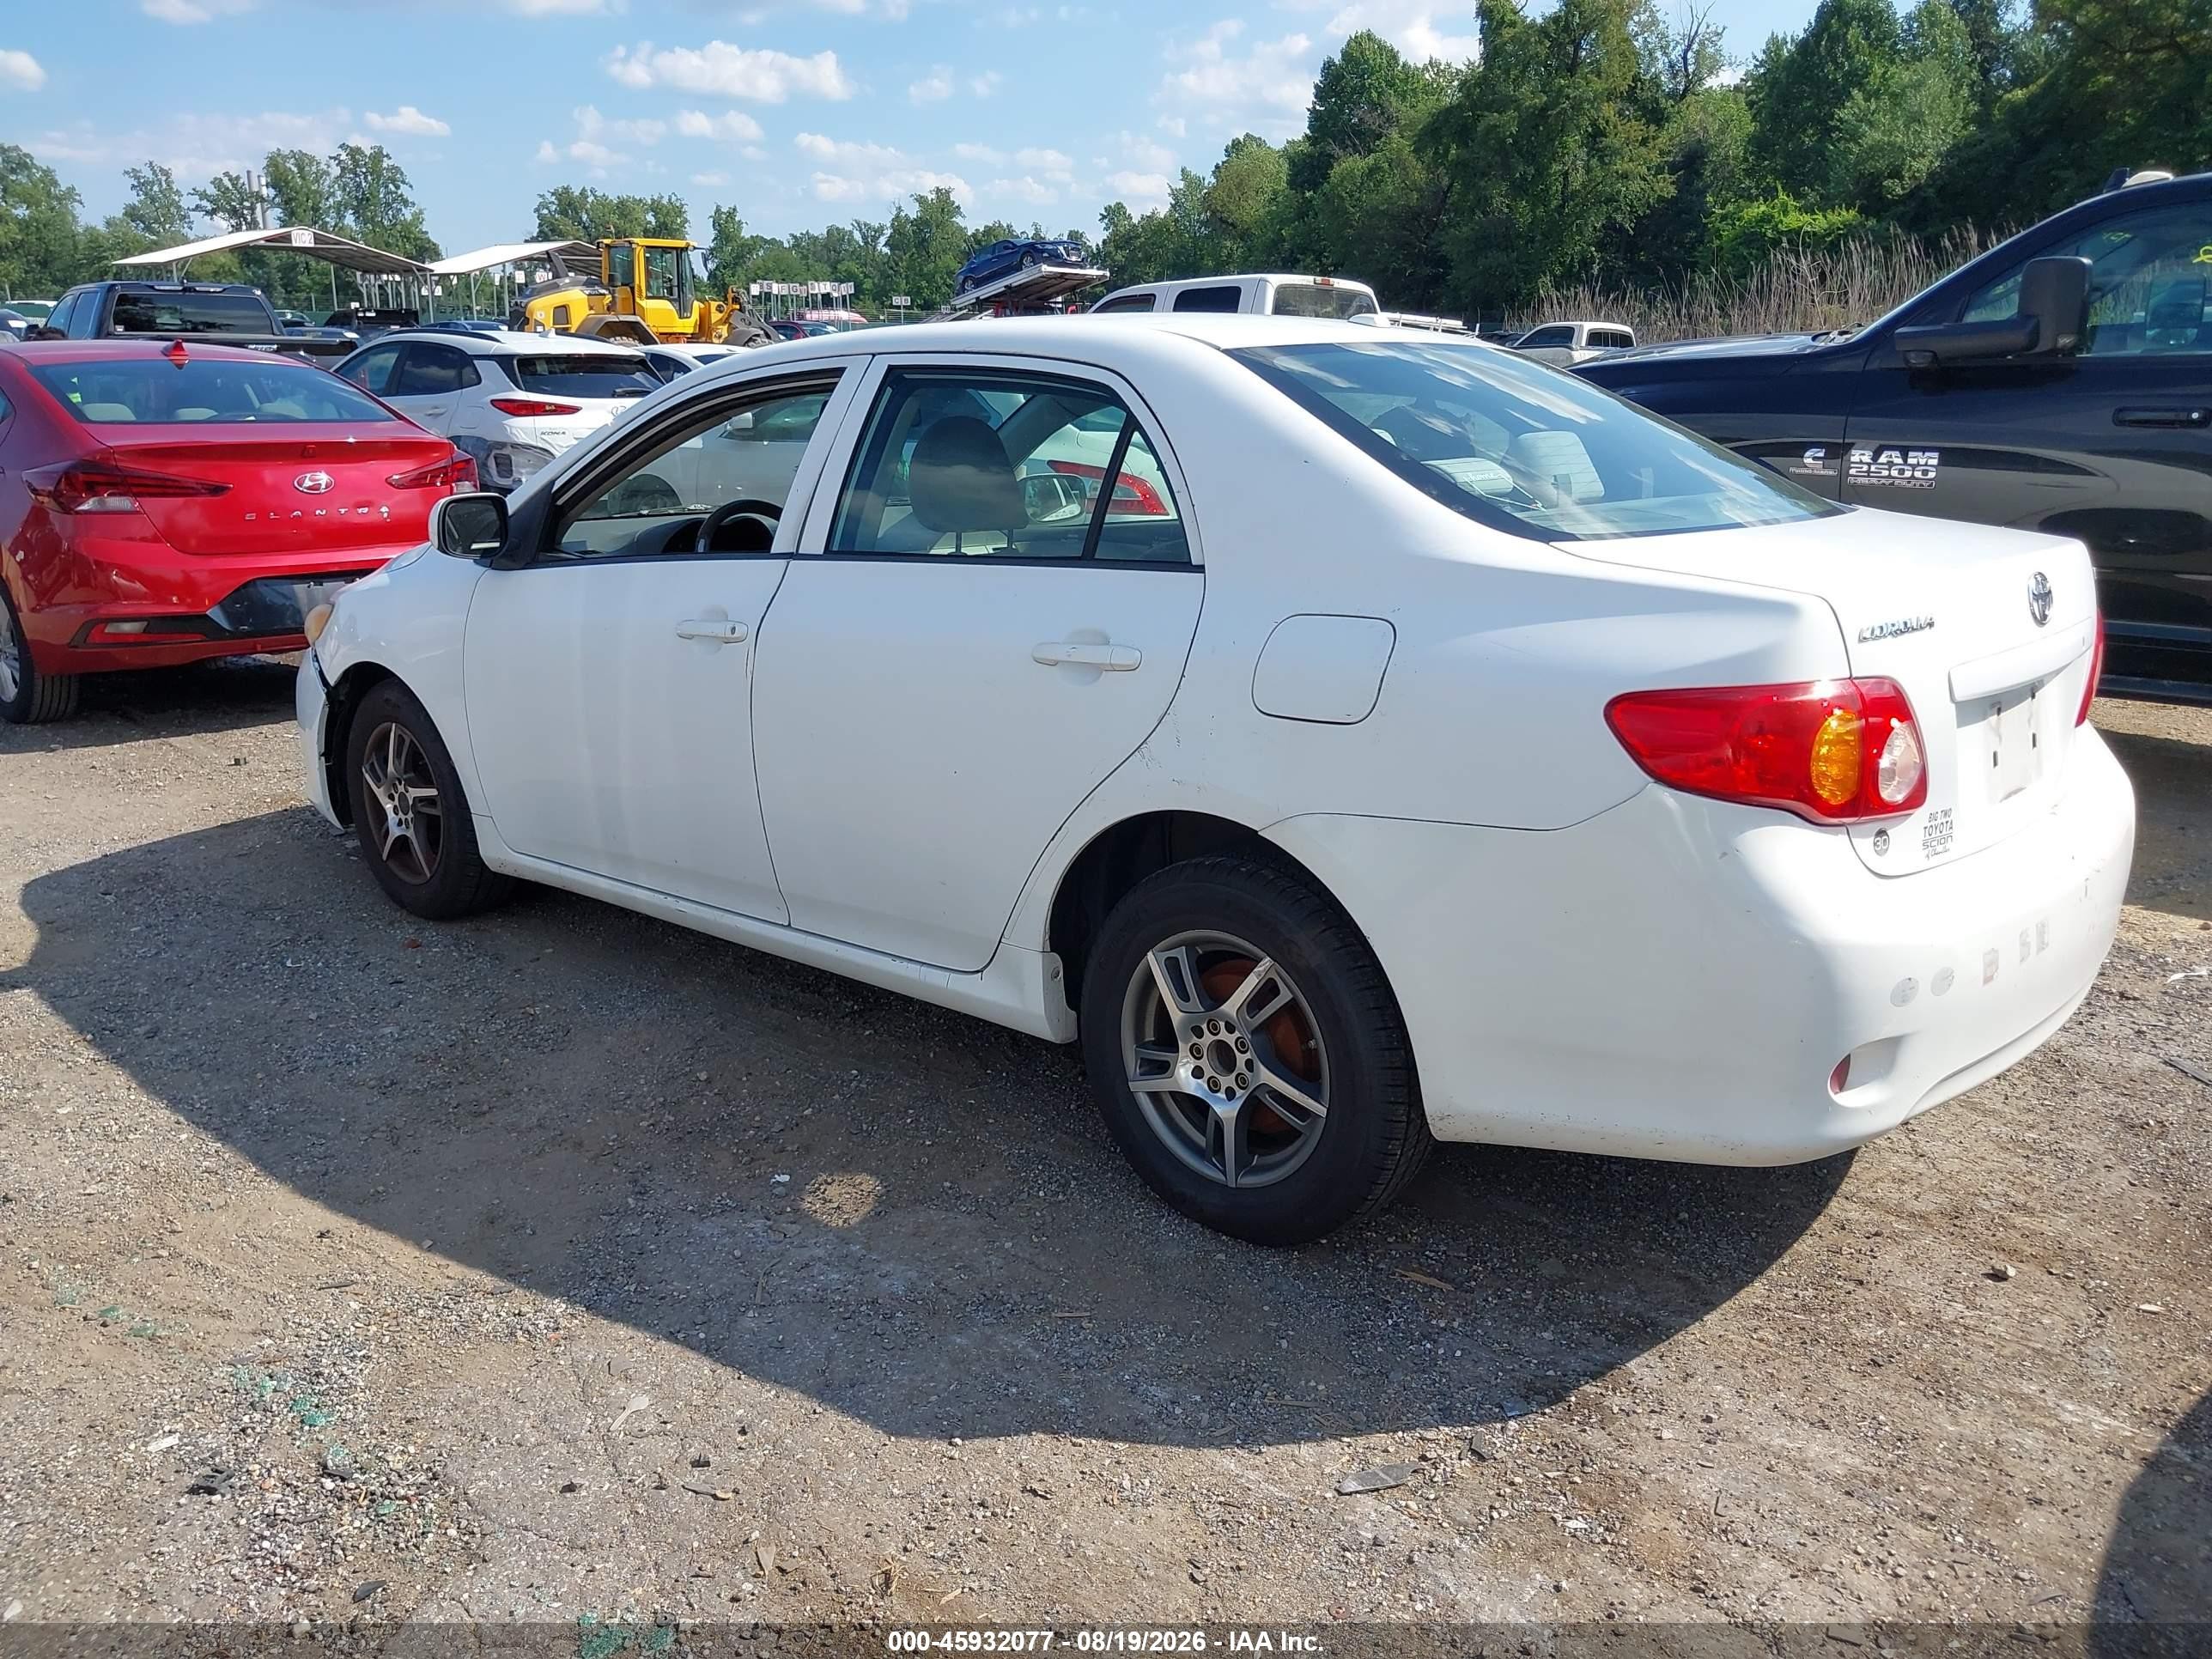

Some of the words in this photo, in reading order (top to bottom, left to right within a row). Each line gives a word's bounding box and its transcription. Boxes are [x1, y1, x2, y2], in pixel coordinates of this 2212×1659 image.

[292, 232, 307, 245] VIC
[307, 233, 313, 245] 2
[1850, 449, 1940, 466] RAM
[1849, 465, 1937, 479] 2500
[1849, 477, 1893, 487] HEAVY
[1893, 480, 1934, 489] DUTY
[244, 505, 391, 522] ELANTRA
[1928, 811, 1939, 823] BIG
[1940, 807, 1953, 820] TWO
[1923, 819, 1954, 839] TOYOTA
